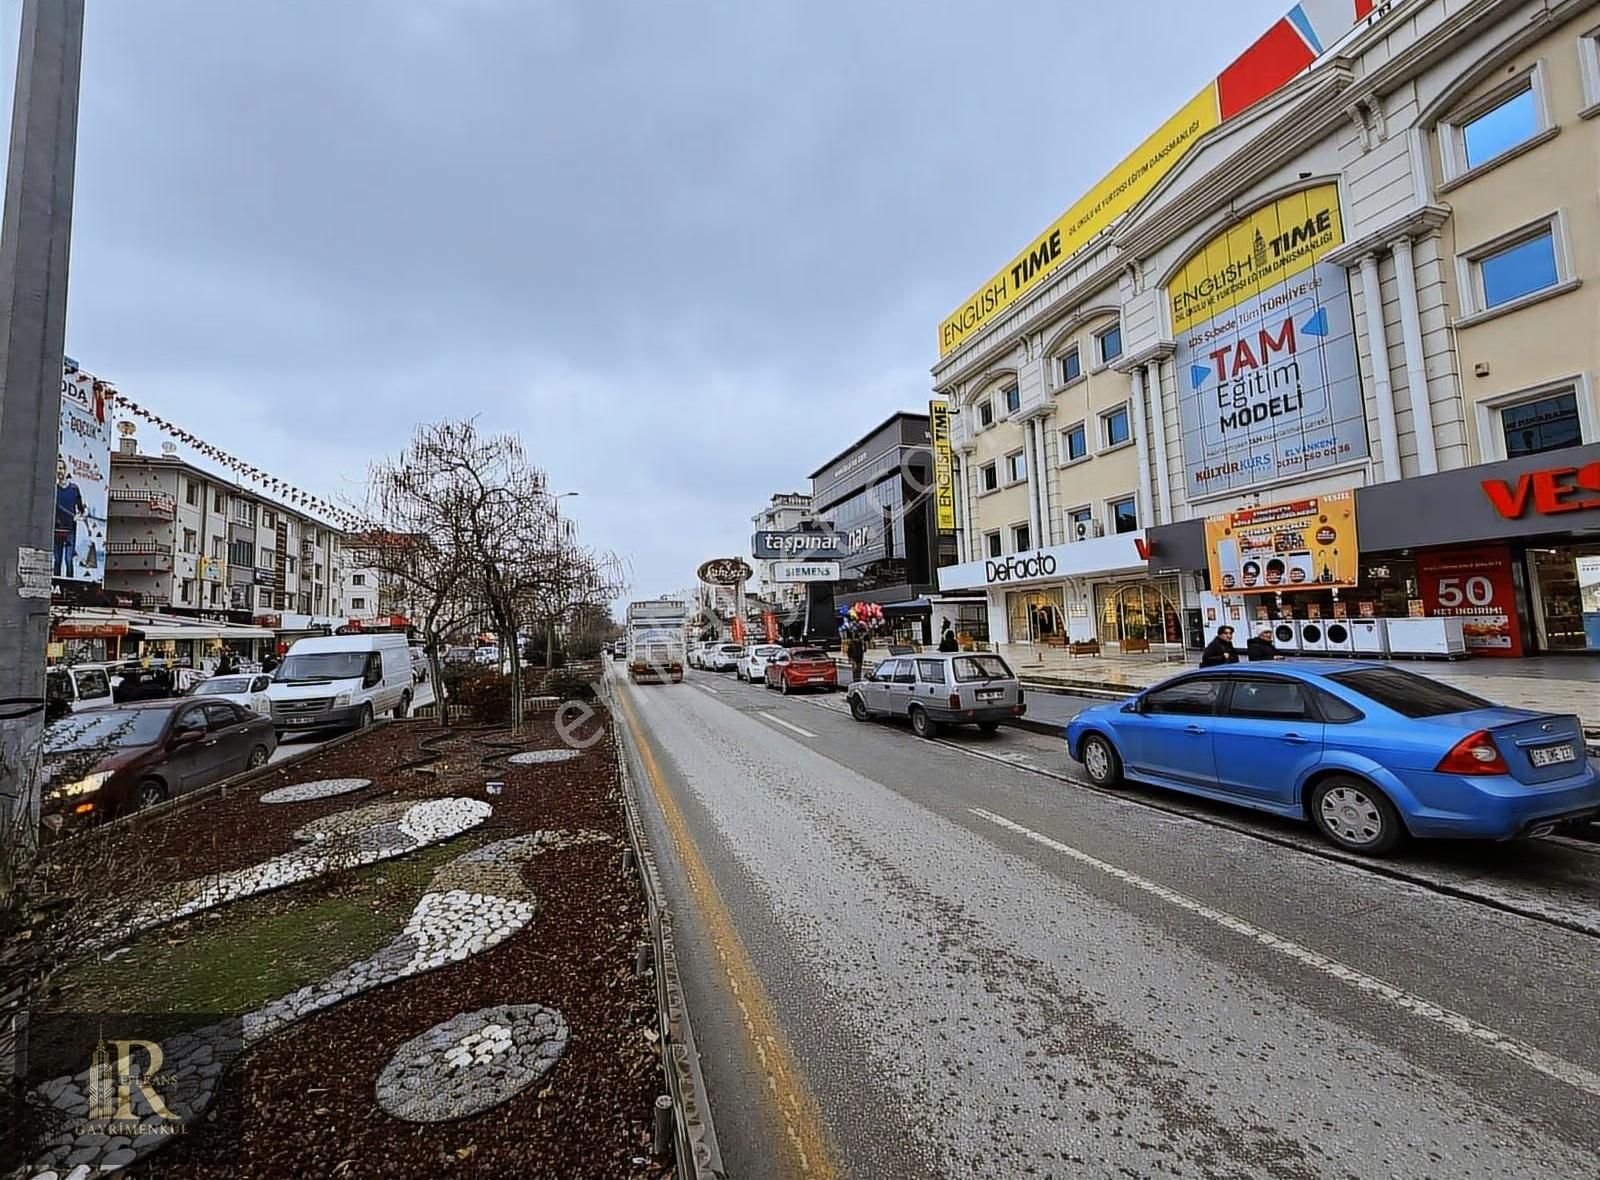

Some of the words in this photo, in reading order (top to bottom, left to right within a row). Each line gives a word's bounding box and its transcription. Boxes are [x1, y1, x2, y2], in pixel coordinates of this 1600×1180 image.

[1174, 254, 1252, 312] ENGLISH
[1269, 208, 1331, 257] TIME
[944, 277, 1006, 347] ENGLISH
[1011, 229, 1061, 289] TIME
[1204, 319, 1236, 343] Şubede
[1209, 316, 1297, 381] TAM
[1217, 361, 1299, 408] Eğitim
[935, 406, 948, 441] TIME
[1220, 384, 1303, 433] MODELİ
[1285, 436, 1338, 457] ELVANKENT
[937, 441, 952, 507] ENGLISH
[765, 534, 840, 553] taşpınar
[785, 567, 831, 577] SIEMENS
[985, 551, 1056, 583] DeFacto
[1438, 576, 1493, 607] 50
[1433, 608, 1453, 616] NET
